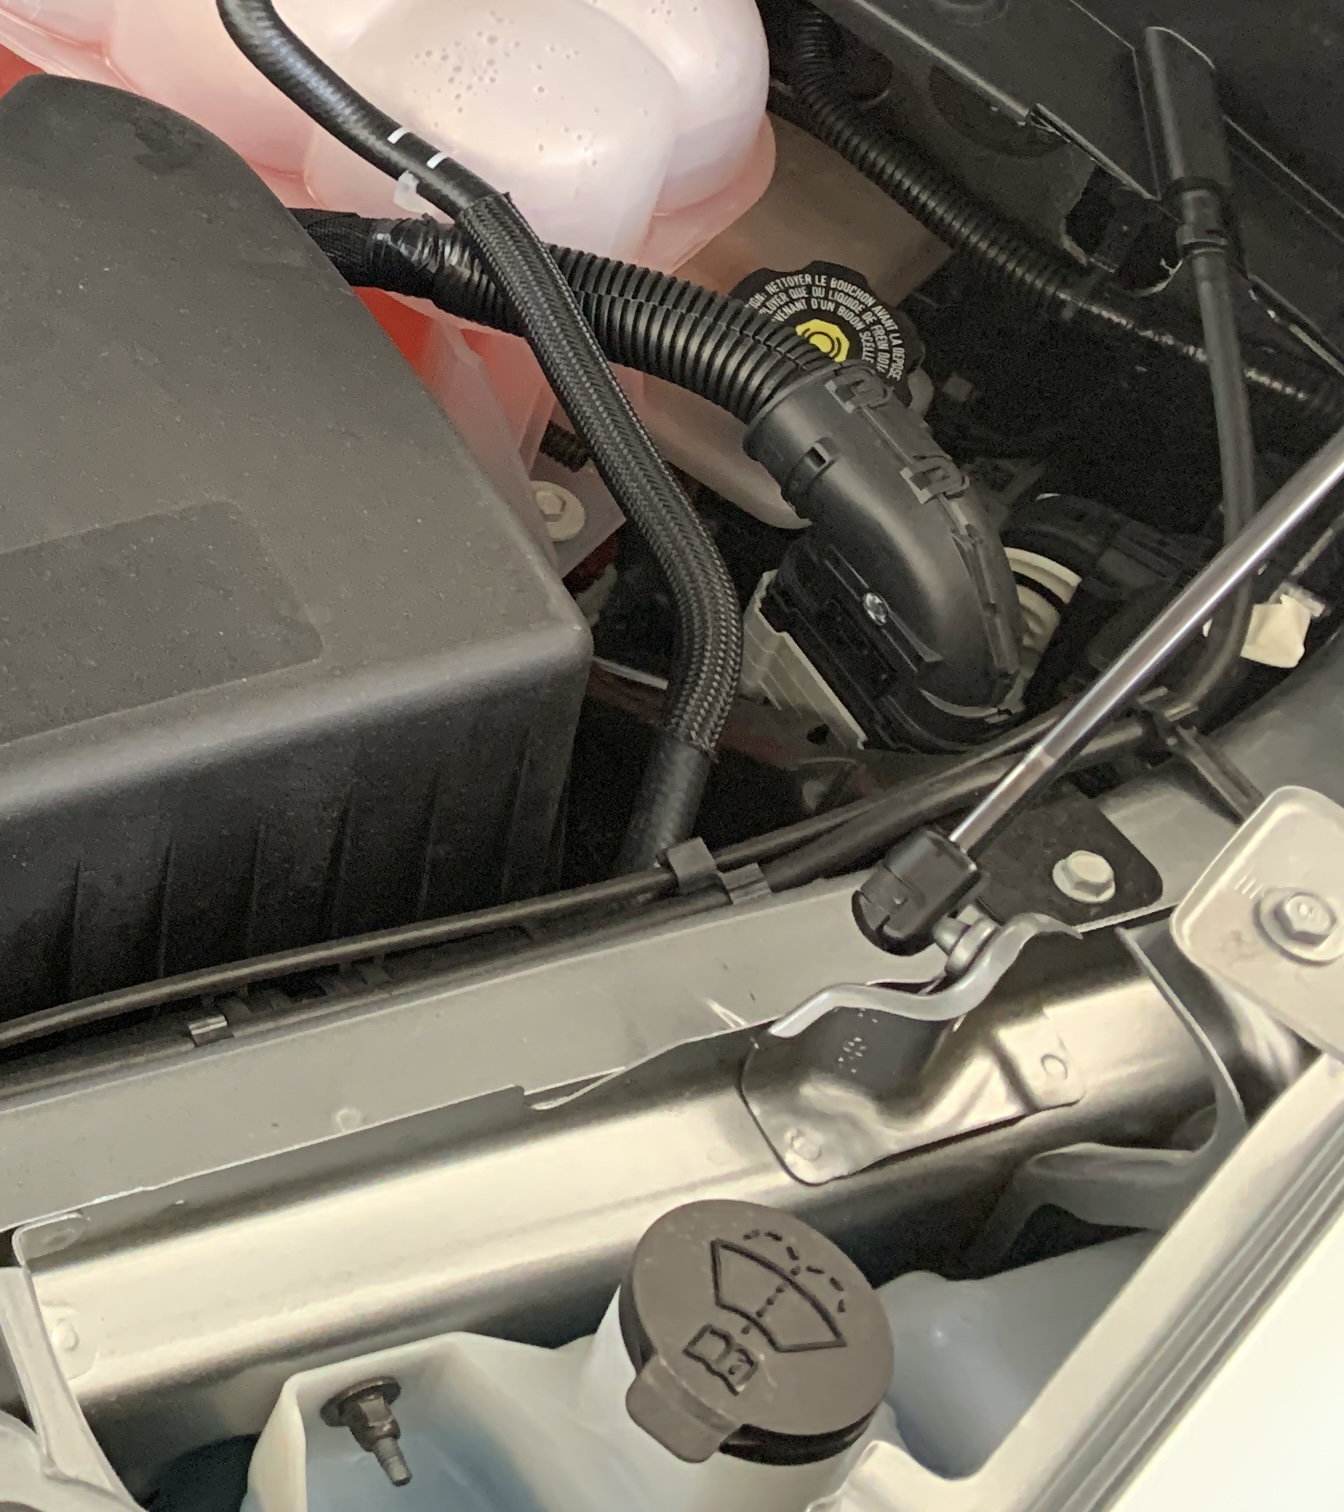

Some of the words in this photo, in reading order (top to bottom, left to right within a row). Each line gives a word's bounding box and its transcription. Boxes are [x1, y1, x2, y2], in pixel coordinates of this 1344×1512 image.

[765, 273, 812, 295] NETTOYER
[815, 275, 827, 286] LE
[830, 277, 876, 307] BOUCHON
[872, 305, 899, 331] AVANT
[889, 333, 903, 346] LA
[790, 286, 809, 299] QUE
[812, 287, 825, 298] DU
[828, 289, 865, 315] LIQUIDE
[862, 310, 877, 325] DE
[871, 324, 889, 350] FREIN
[811, 298, 835, 312] D'UN
[837, 305, 865, 331] BIDON
